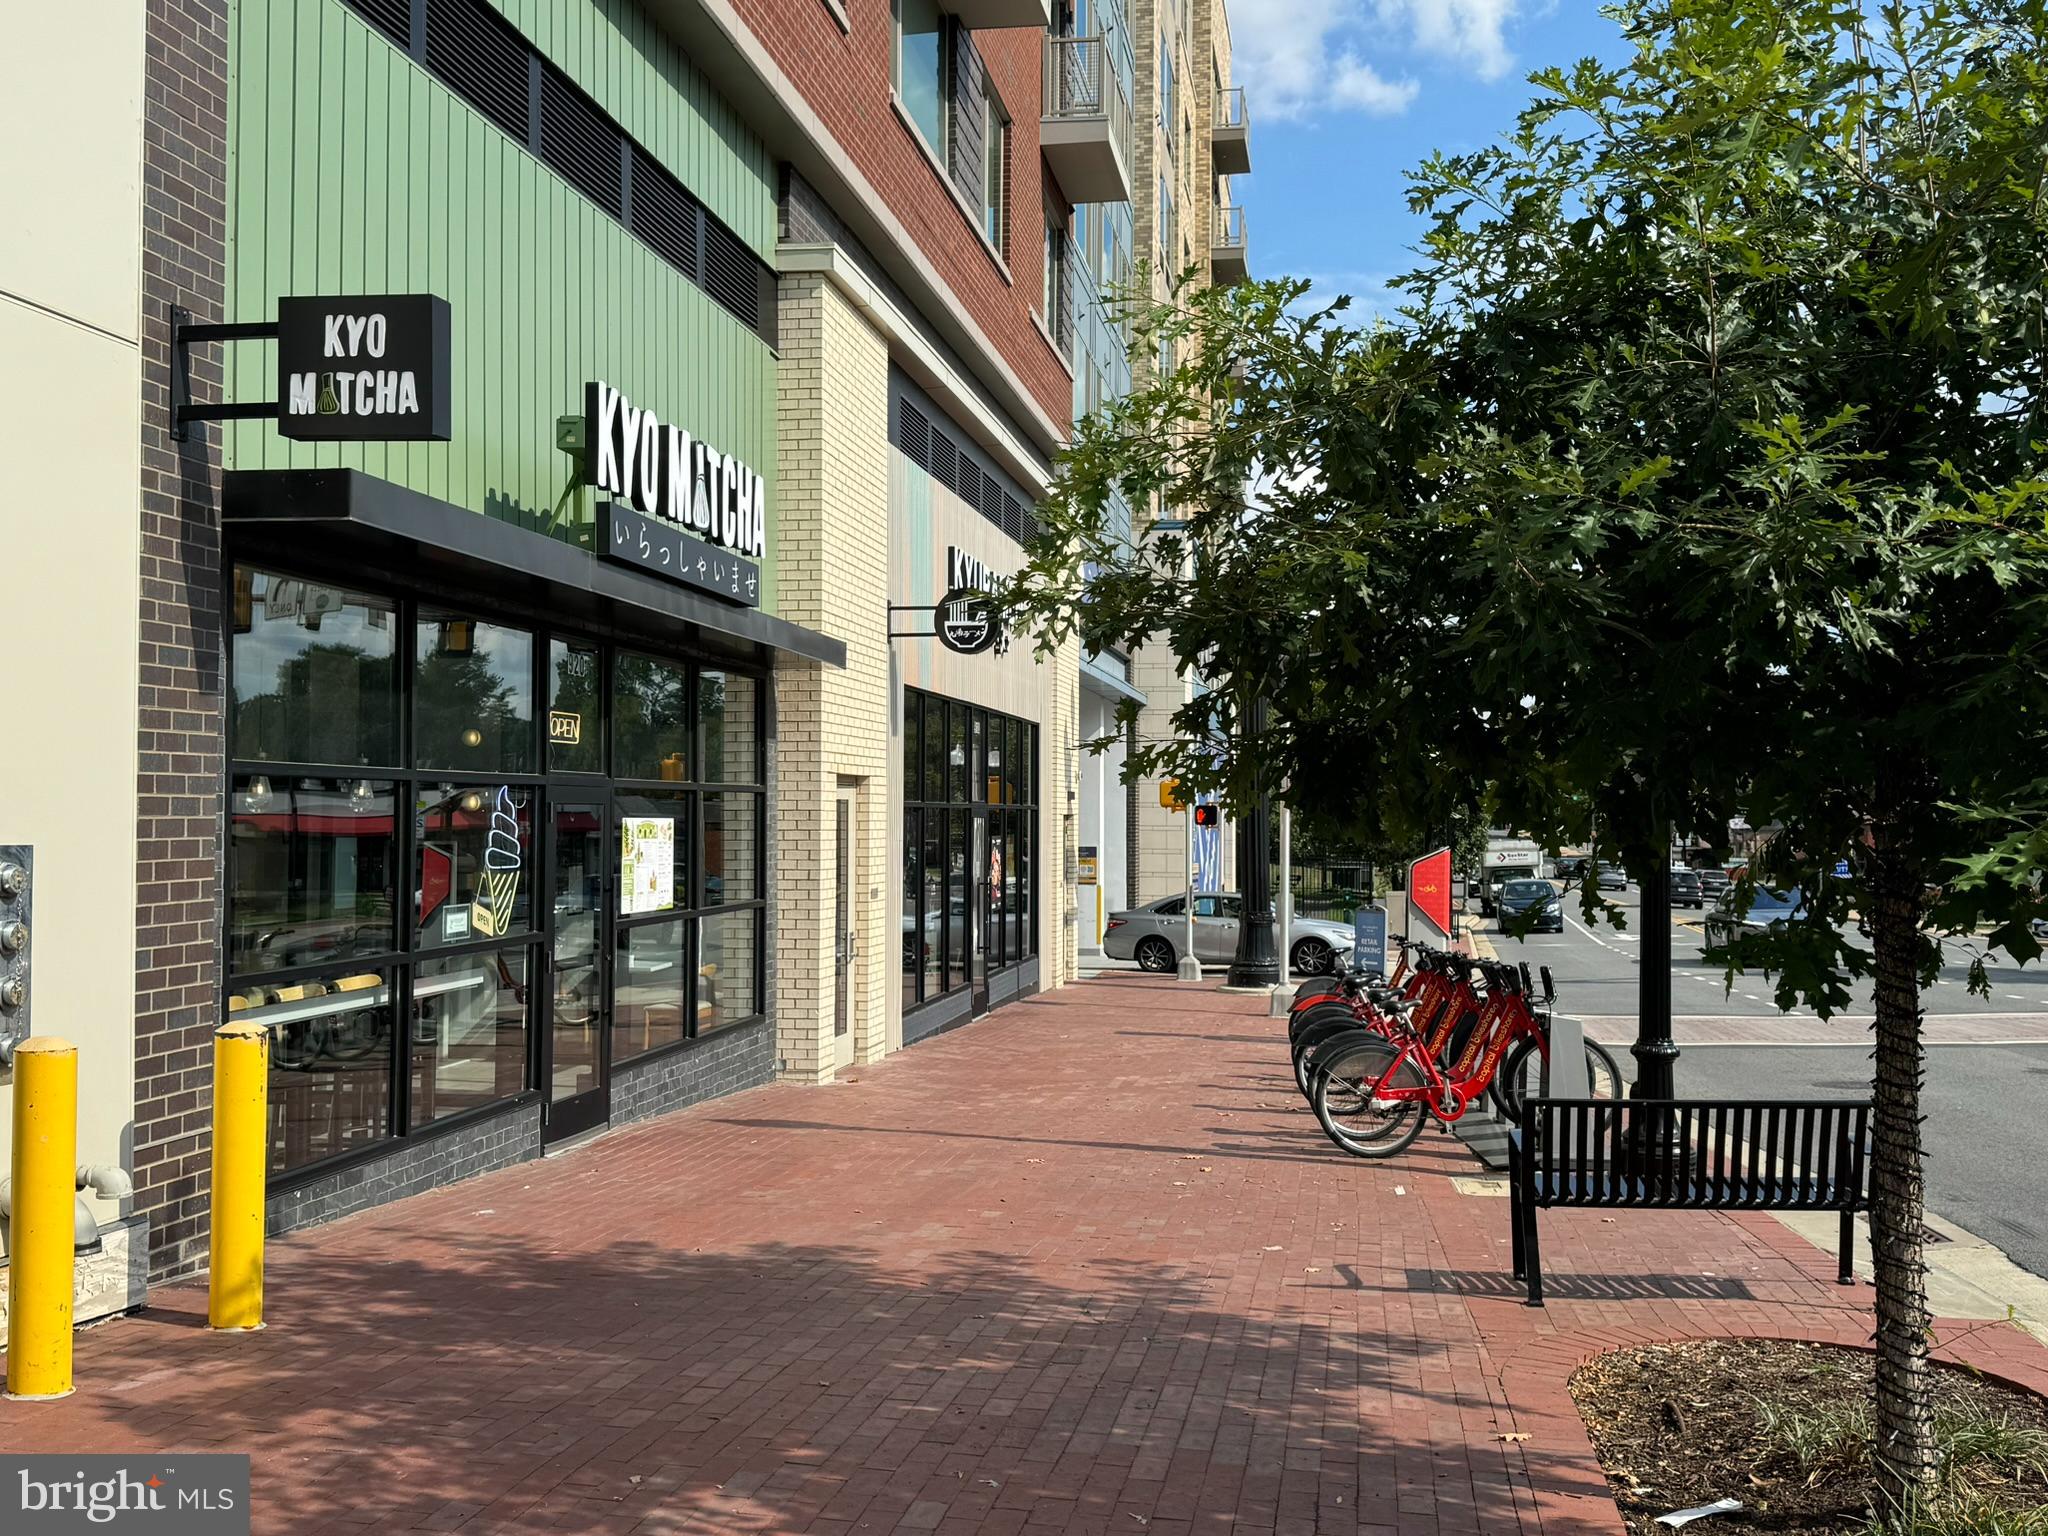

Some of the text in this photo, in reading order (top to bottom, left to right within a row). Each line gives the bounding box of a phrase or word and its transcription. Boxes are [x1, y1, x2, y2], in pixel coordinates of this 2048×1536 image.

[324, 313, 386, 358] KYO
[597, 380, 659, 514] KYO
[615, 520, 757, 598] いらっしゃいませ
[568, 653, 585, 676] 920
[551, 717, 579, 738] OPEN
[477, 912, 490, 927] OPEN
[1357, 946, 1382, 954] PARKING
[1361, 938, 1378, 946] RETAIL
[1430, 1028, 1445, 1055] capital
[1459, 1043, 1475, 1072] capital
[1479, 1054, 1495, 1082] capital
